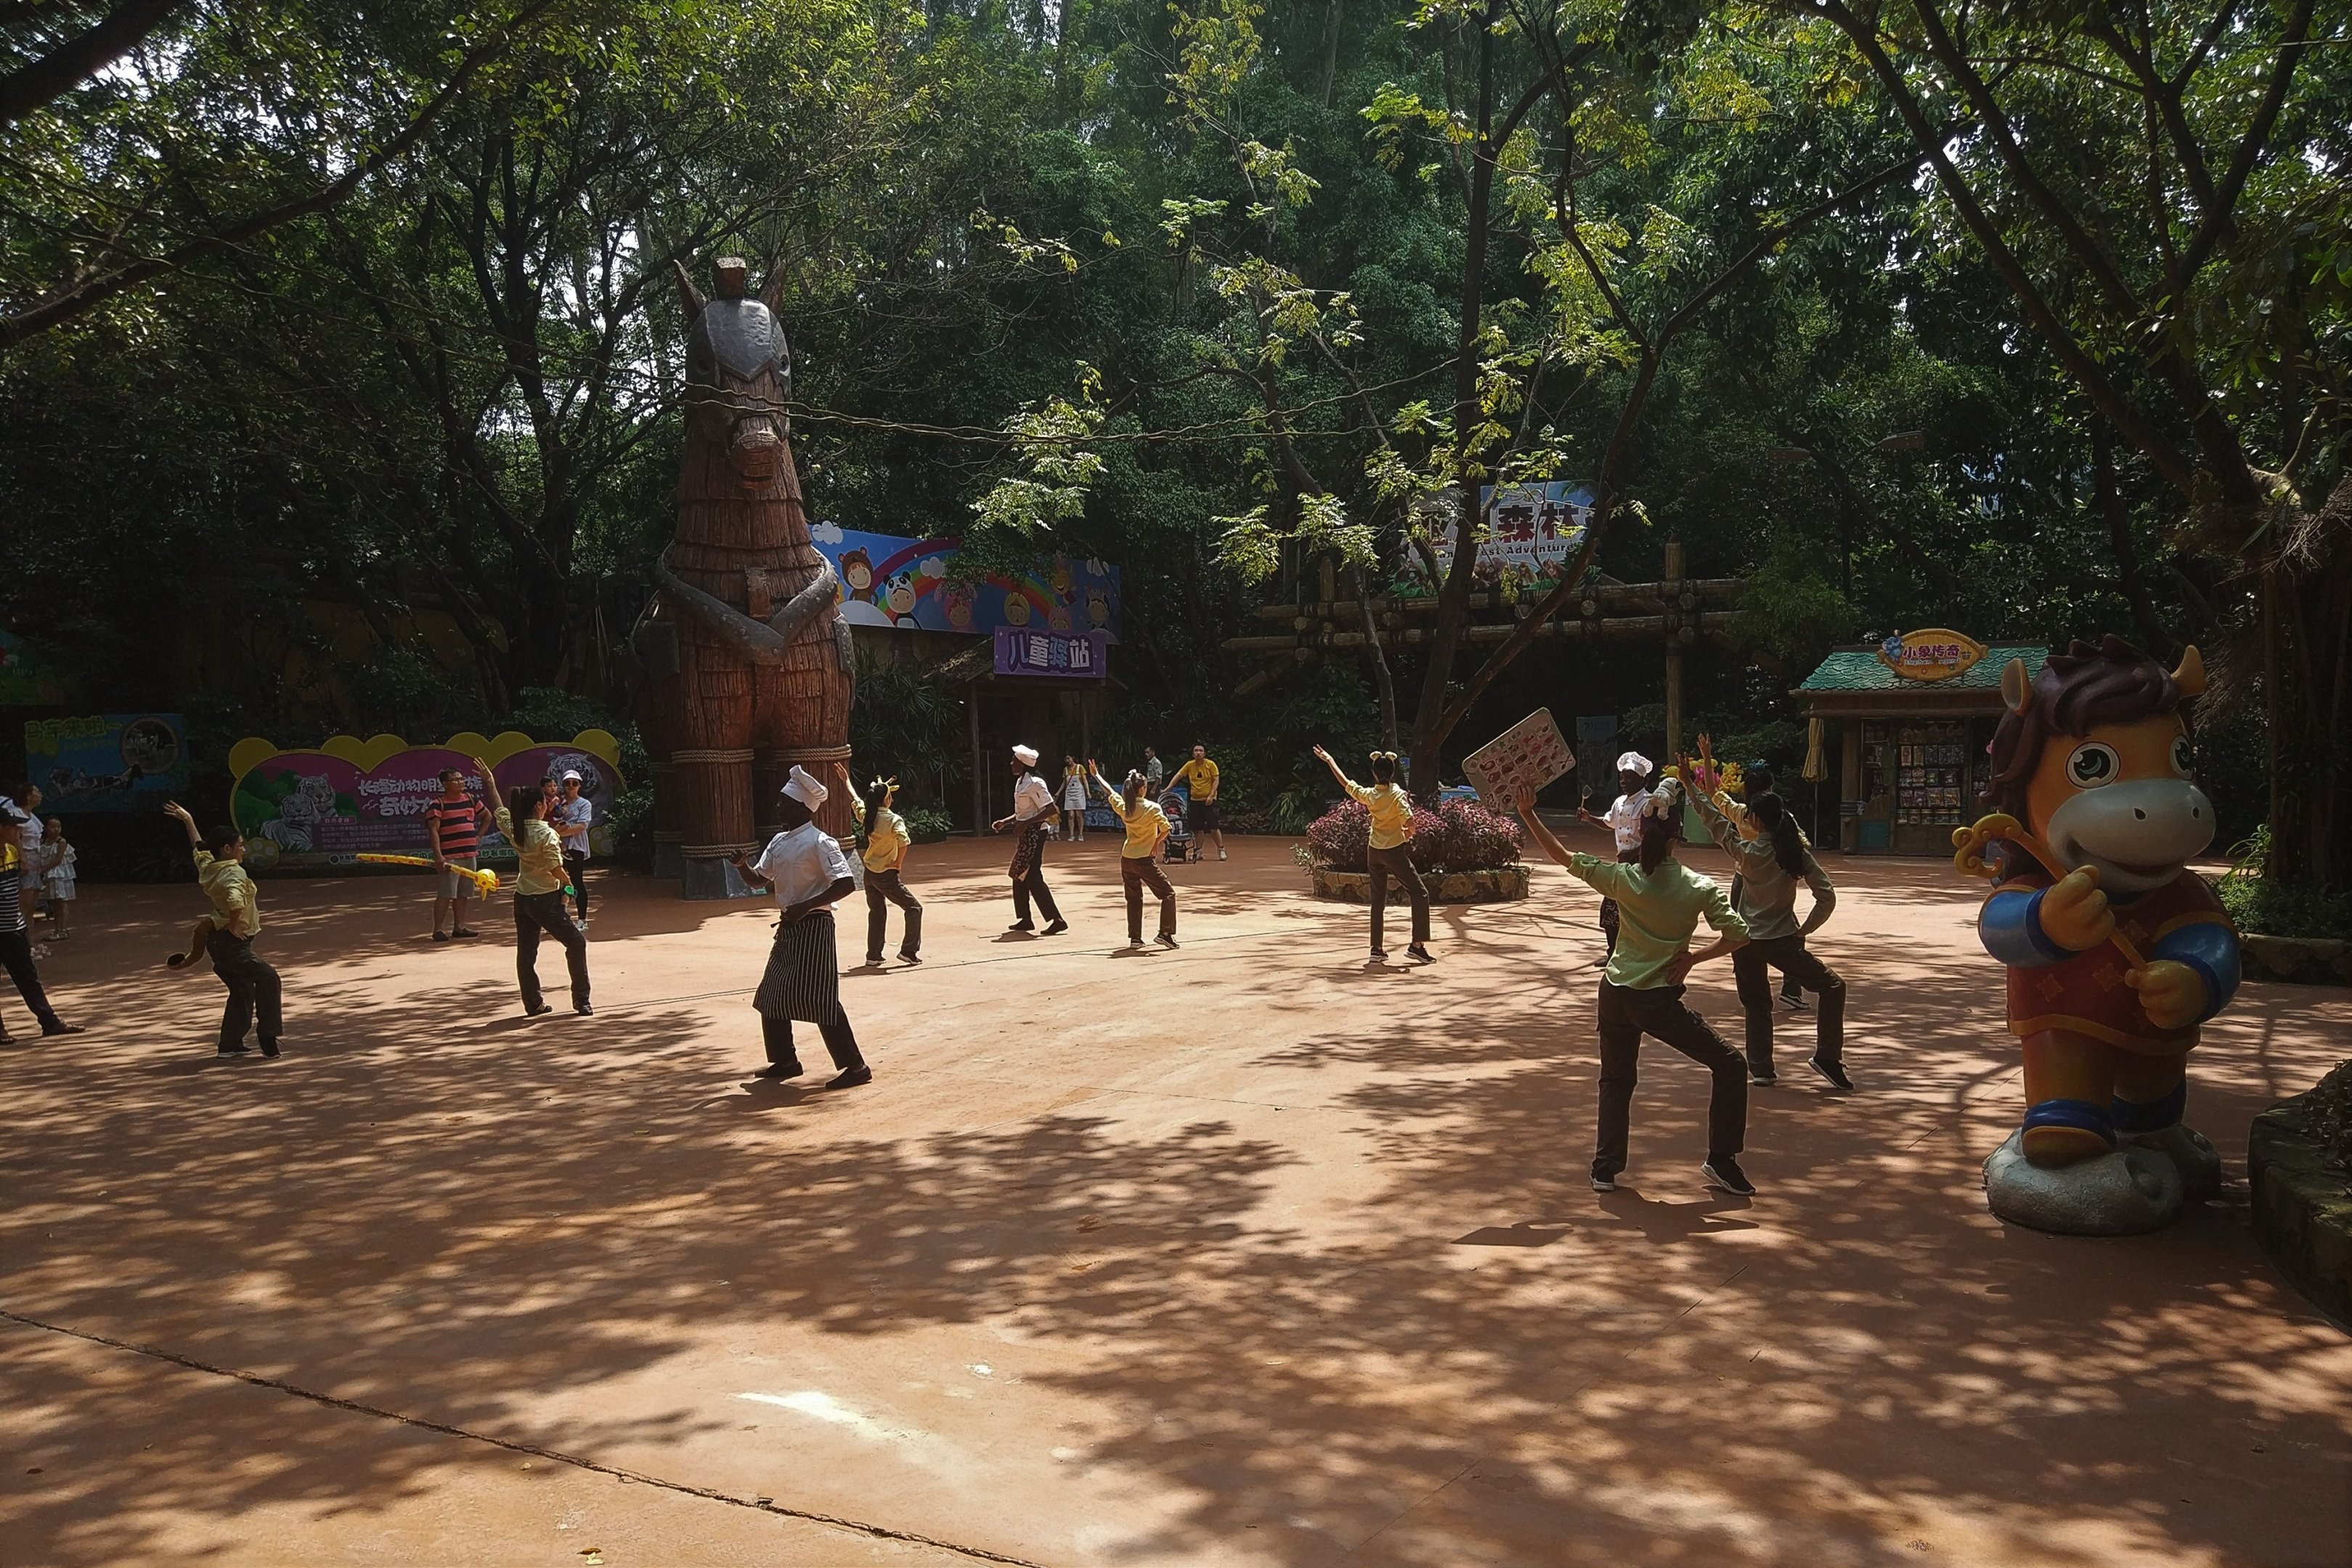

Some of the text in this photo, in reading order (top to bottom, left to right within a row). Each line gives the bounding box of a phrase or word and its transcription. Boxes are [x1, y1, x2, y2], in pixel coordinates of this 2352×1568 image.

[1507, 544, 1574, 555] Adventure
[1010, 634, 1090, 669] 儿童驿站
[1903, 643, 1961, 659] 小象传奇
[358, 776, 482, 796] 长隆动物明星族
